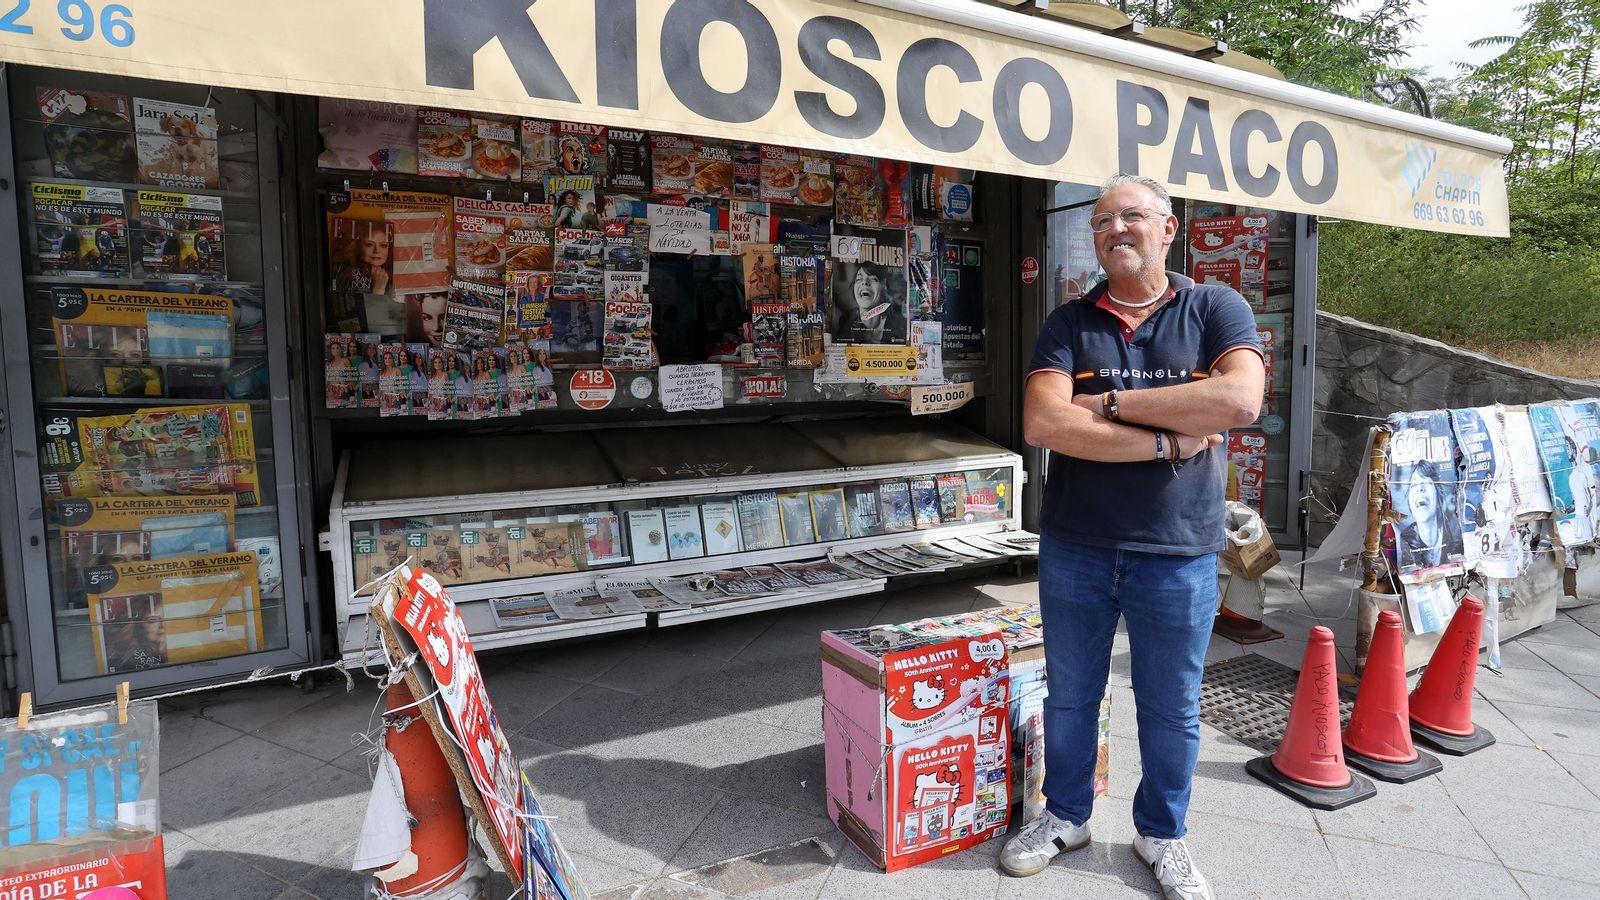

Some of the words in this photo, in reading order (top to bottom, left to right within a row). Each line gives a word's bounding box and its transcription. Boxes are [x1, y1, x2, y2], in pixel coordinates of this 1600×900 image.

[57, 0, 136, 48] 96
[423, 0, 1073, 166] KIOSCO
[1116, 79, 1338, 205] PACO
[136, 104, 168, 118] Jara
[418, 111, 451, 119] SABER
[560, 121, 605, 134] muy
[608, 130, 644, 142] muy
[650, 135, 678, 143] SABER
[701, 147, 728, 156] TARTAS
[761, 145, 786, 153] SABER
[697, 152, 732, 162] SALADAS
[148, 172, 207, 183] CAZADORES
[34, 186, 82, 197] Ciclismo
[140, 193, 184, 204] Ciclismo
[366, 193, 402, 202] CARTERA
[417, 196, 450, 204] VERANO
[93, 208, 122, 216] MUNDO
[457, 199, 502, 212] DELICIAS
[504, 203, 551, 214] CASERAS
[141, 211, 152, 219] NO
[174, 213, 193, 221] ESTE
[674, 208, 697, 218] VENTA
[732, 213, 752, 222] JUEGO
[1413, 202, 1433, 221] 669
[1436, 205, 1450, 224] 63
[1452, 207, 1467, 226] 62
[1469, 210, 1485, 227] 96
[456, 215, 487, 224] SABER
[1195, 221, 1216, 229] HELLO
[1216, 219, 1236, 227] KITTY
[512, 229, 546, 238] TARTAS
[732, 223, 742, 232] NO
[744, 224, 751, 232] SE
[509, 236, 551, 245] SALADAS
[655, 233, 692, 249] NAVIDAD
[838, 237, 859, 256] 60
[780, 255, 816, 268] HISTORIA
[452, 280, 504, 297] MOTOCICLISMO
[91, 293, 106, 303] LA
[108, 294, 160, 306] CARTERA
[163, 296, 182, 306] DEL
[185, 297, 229, 309] VERANO
[676, 365, 704, 373] ABRIMOS
[865, 360, 903, 368] 4.500.000
[580, 370, 605, 384] +18
[922, 390, 965, 404] 500.000
[879, 482, 909, 493] HOBBY
[910, 480, 935, 490] HOBBY
[95, 500, 110, 509] LA
[112, 498, 164, 508] CARTERA
[166, 498, 185, 507] DEL
[187, 497, 230, 507] VERANO
[738, 491, 777, 506] HISTORIA
[68, 531, 150, 555] ELLE
[746, 540, 774, 551] MÉRIDA
[120, 566, 134, 574] LA
[136, 561, 189, 574] CARTERA
[191, 559, 207, 568] DEL
[209, 554, 252, 566] VERANO
[975, 643, 992, 653] 4,00
[894, 654, 927, 672] HELLO
[930, 648, 958, 662] KITTY
[904, 669, 919, 678] 50th
[919, 663, 953, 676] Anniversary
[1313, 662, 1332, 699] PACO
[927, 711, 946, 725] SOBRES
[914, 725, 933, 735] GRATIS
[907, 749, 939, 765] HELLO
[940, 743, 969, 756] KITTY
[916, 762, 928, 770] 50th
[928, 755, 961, 768] Anniversary
[26, 857, 109, 881] EXTRAORDINARIO
[39, 879, 67, 898] DE
[72, 873, 98, 891] LA
